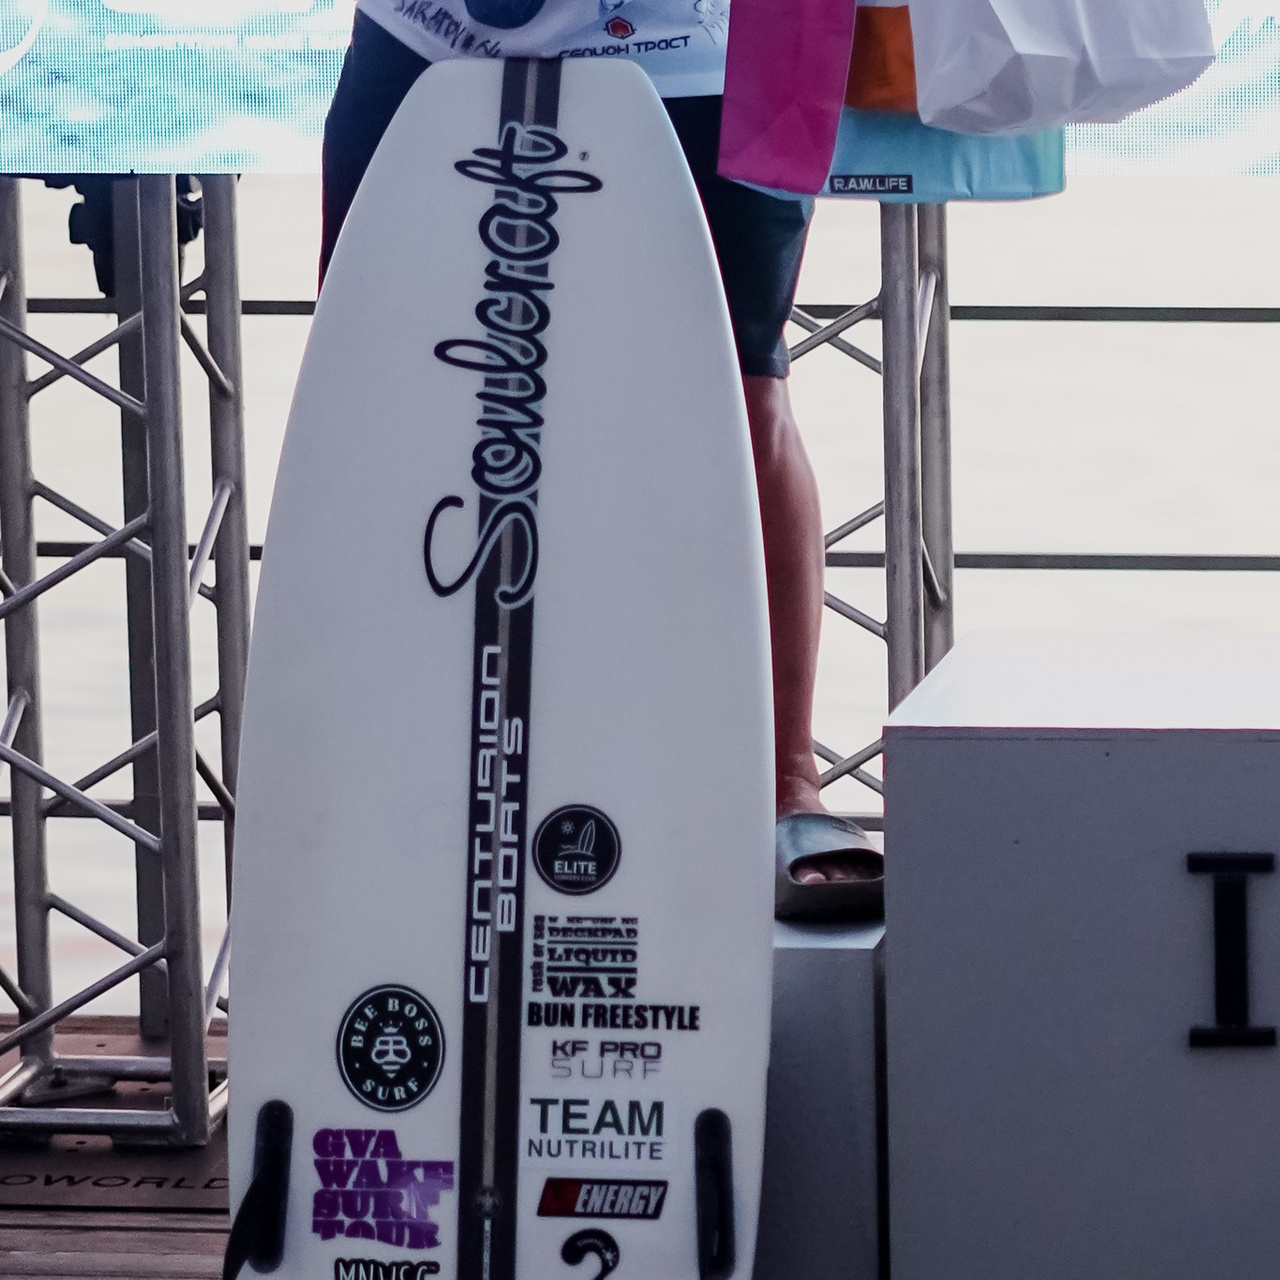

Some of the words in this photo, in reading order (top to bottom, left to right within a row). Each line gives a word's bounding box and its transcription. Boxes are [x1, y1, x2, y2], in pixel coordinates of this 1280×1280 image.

[469, 645, 502, 1003] CENTURION
[497, 717, 523, 932] BOATS
[554, 860, 597, 875] ELITE
[547, 947, 637, 966] LIQUID
[1186, 851, 1278, 1049] I
[547, 975, 637, 999] WAX
[350, 1004, 378, 1048] BEE
[388, 998, 432, 1047] BOSS
[527, 1001, 575, 1028] BUN
[581, 1003, 700, 1030] FREESTYLE
[552, 1039, 589, 1058] KF
[600, 1041, 662, 1060] PRO
[551, 1058, 661, 1079] SURF
[362, 1077, 419, 1101] SURF
[530, 1097, 664, 1137] TEAM
[527, 1138, 664, 1160] NUTRILITE
[574, 1183, 665, 1216] ENERGY
